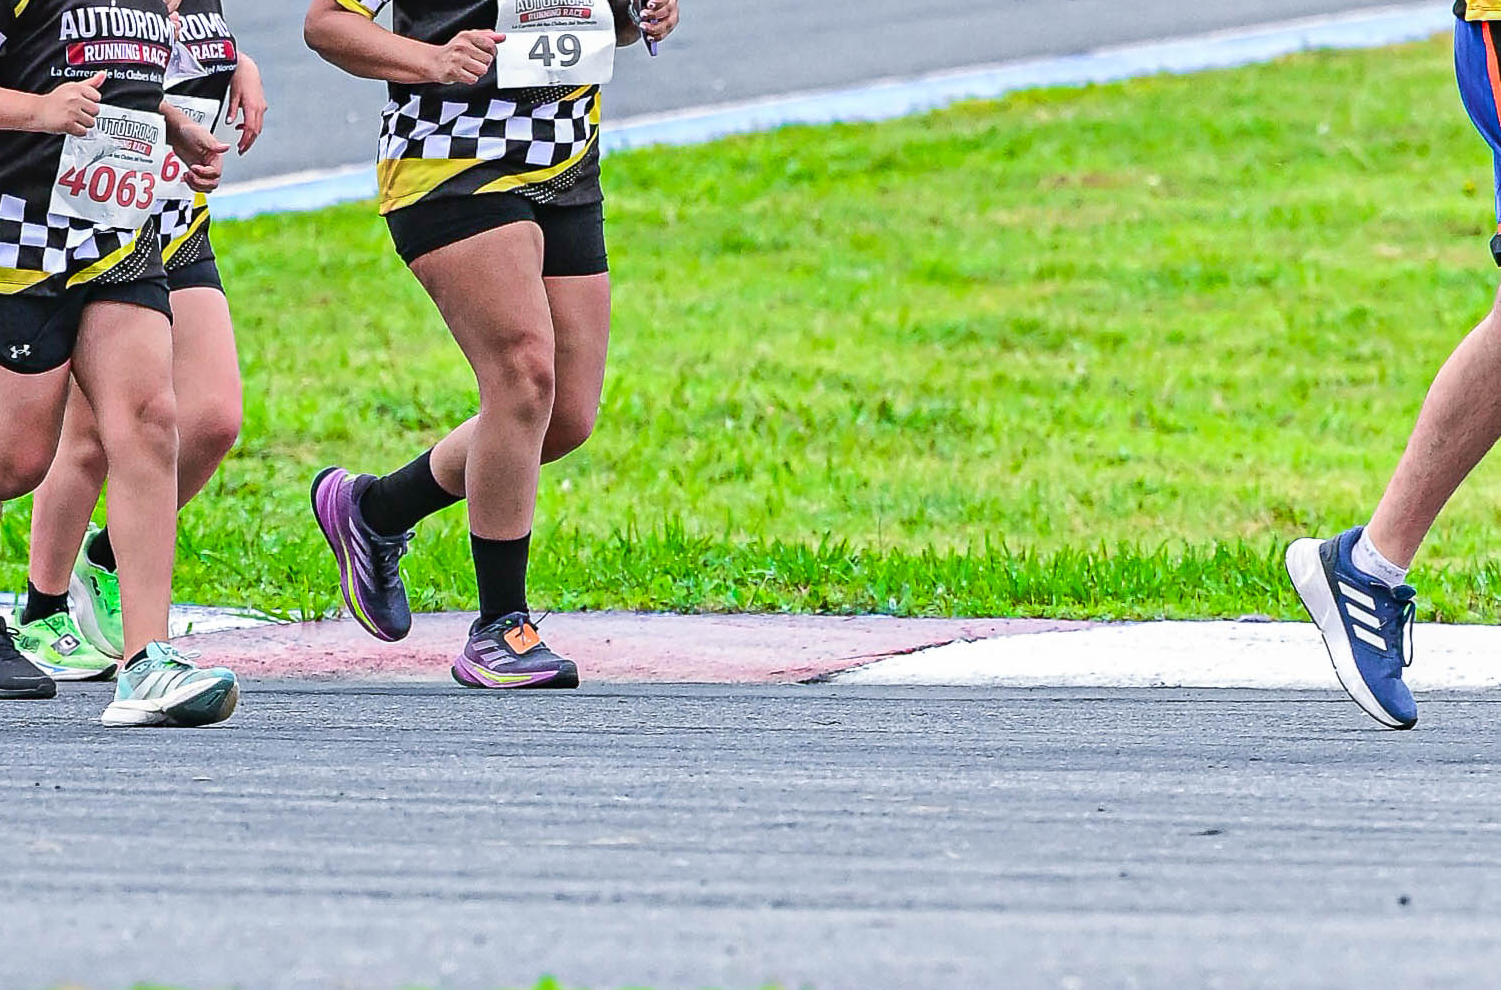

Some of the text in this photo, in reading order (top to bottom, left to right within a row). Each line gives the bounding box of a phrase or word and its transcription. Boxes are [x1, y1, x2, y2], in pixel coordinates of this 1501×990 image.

[59, 0, 172, 46] AUTÓDROM
[84, 43, 169, 68] RUNNING RACE
[191, 43, 226, 61] RACE
[528, 34, 581, 67] 49
[51, 67, 62, 77] La
[114, 70, 125, 80] los
[97, 115, 158, 144] UTÓDROMO
[58, 166, 155, 210] 4063
